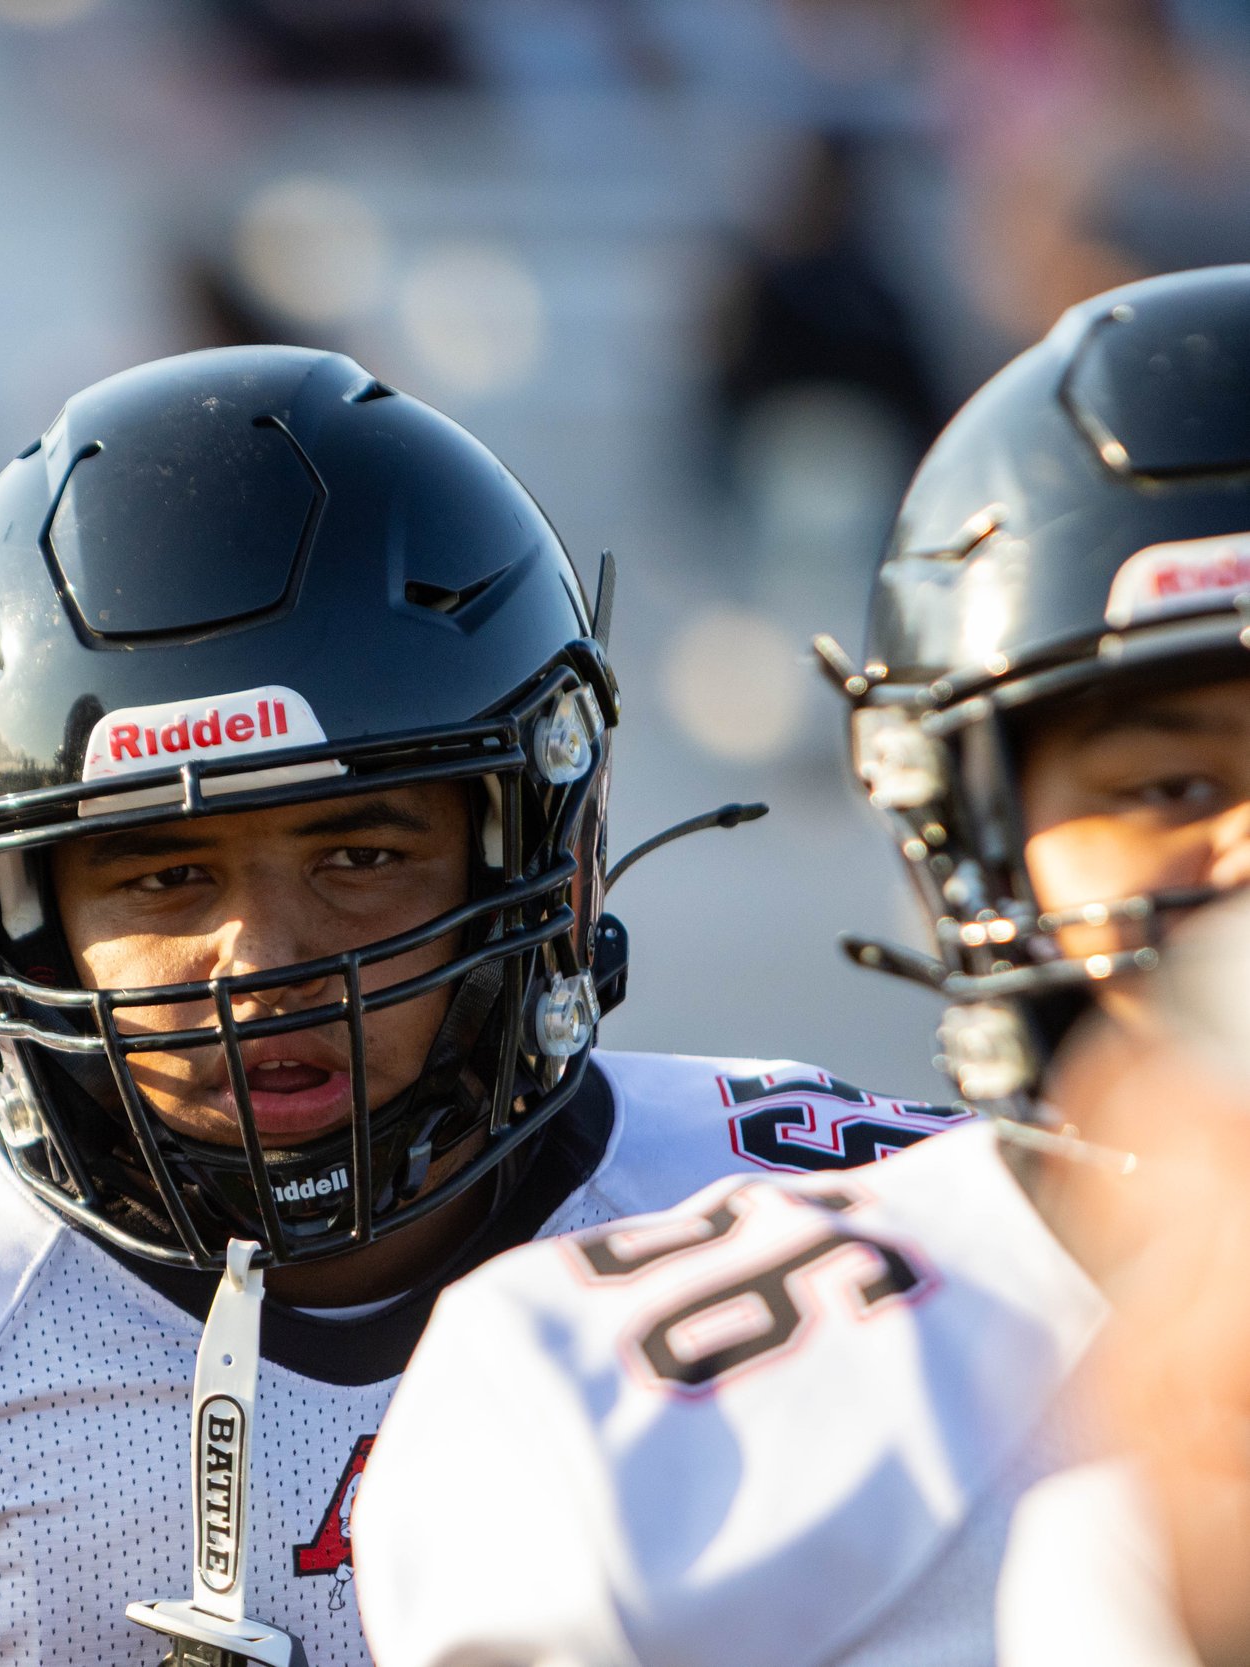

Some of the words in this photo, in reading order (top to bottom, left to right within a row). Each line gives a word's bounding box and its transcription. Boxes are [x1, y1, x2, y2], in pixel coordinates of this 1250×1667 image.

[108, 697, 288, 761] Riddell
[271, 1167, 349, 1203] iddell
[203, 1412, 236, 1577] BATTLE
